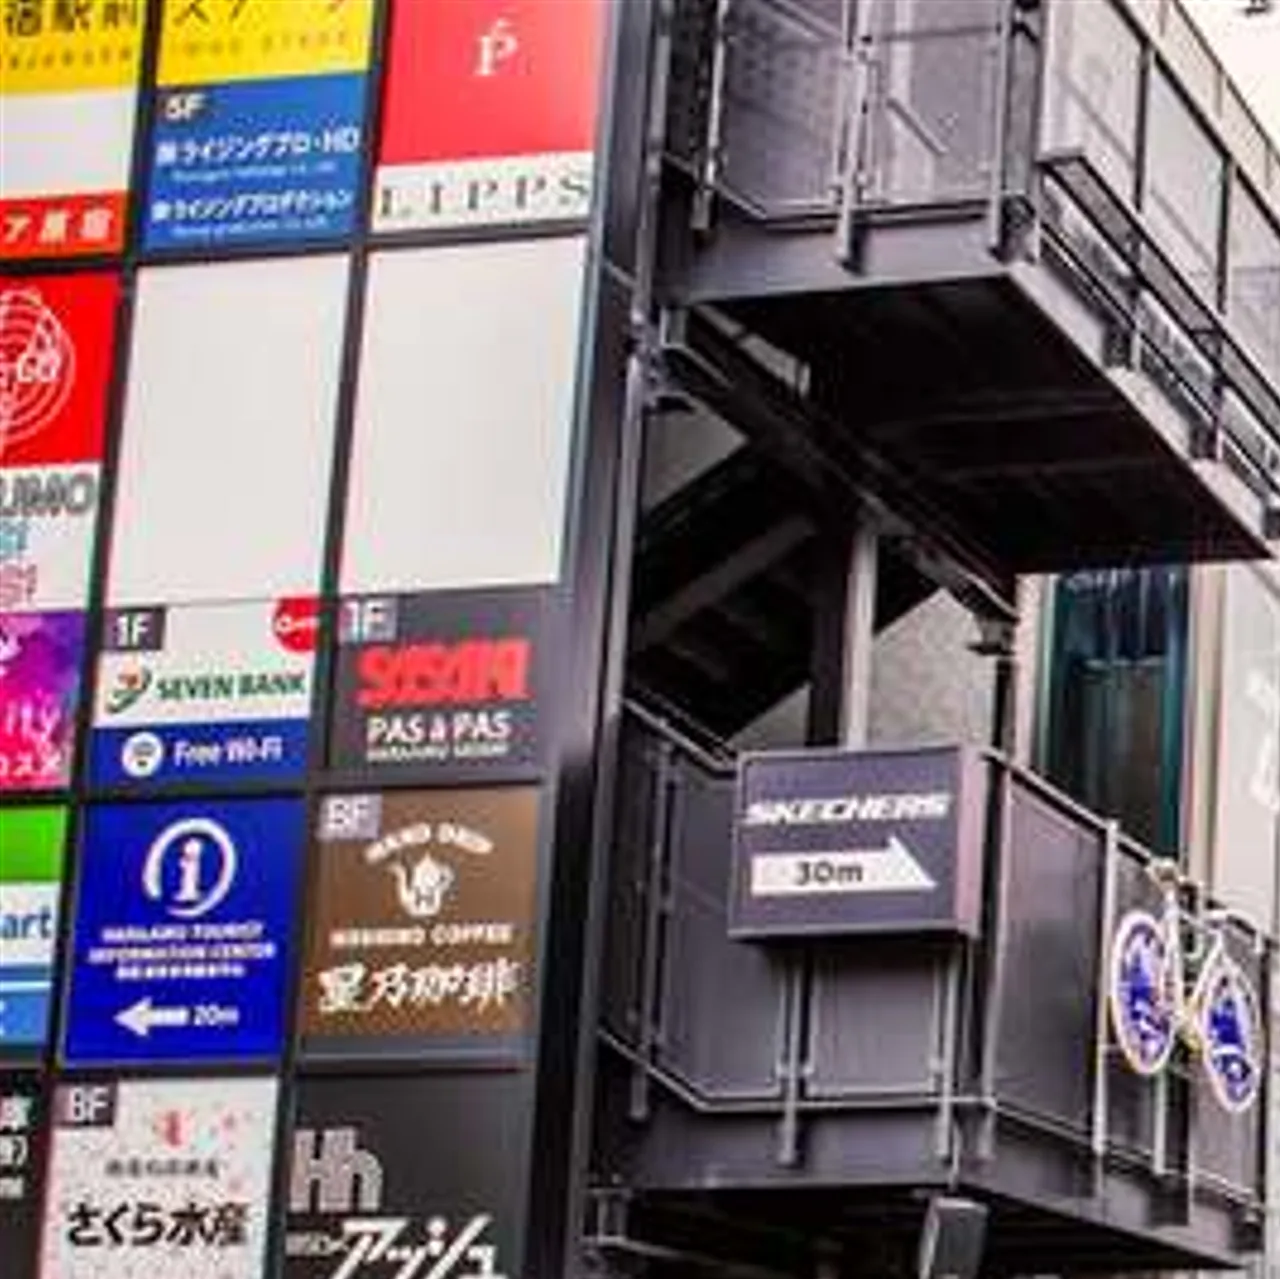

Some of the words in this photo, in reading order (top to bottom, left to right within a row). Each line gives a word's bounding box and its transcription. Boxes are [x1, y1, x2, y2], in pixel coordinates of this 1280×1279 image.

[381, 174, 589, 217] LIPPS
[116, 614, 149, 647] 1F
[344, 600, 384, 642] 1F
[156, 674, 234, 699] SEVEN
[238, 671, 306, 695] BANK
[327, 797, 370, 830] BF
[743, 793, 951, 825] SKECHERS
[793, 859, 864, 885] 30m
[1, 910, 52, 939] art
[193, 1003, 240, 1027] 20m
[70, 1086, 110, 1122] BF
[67, 1201, 249, 1247] さくら水産
